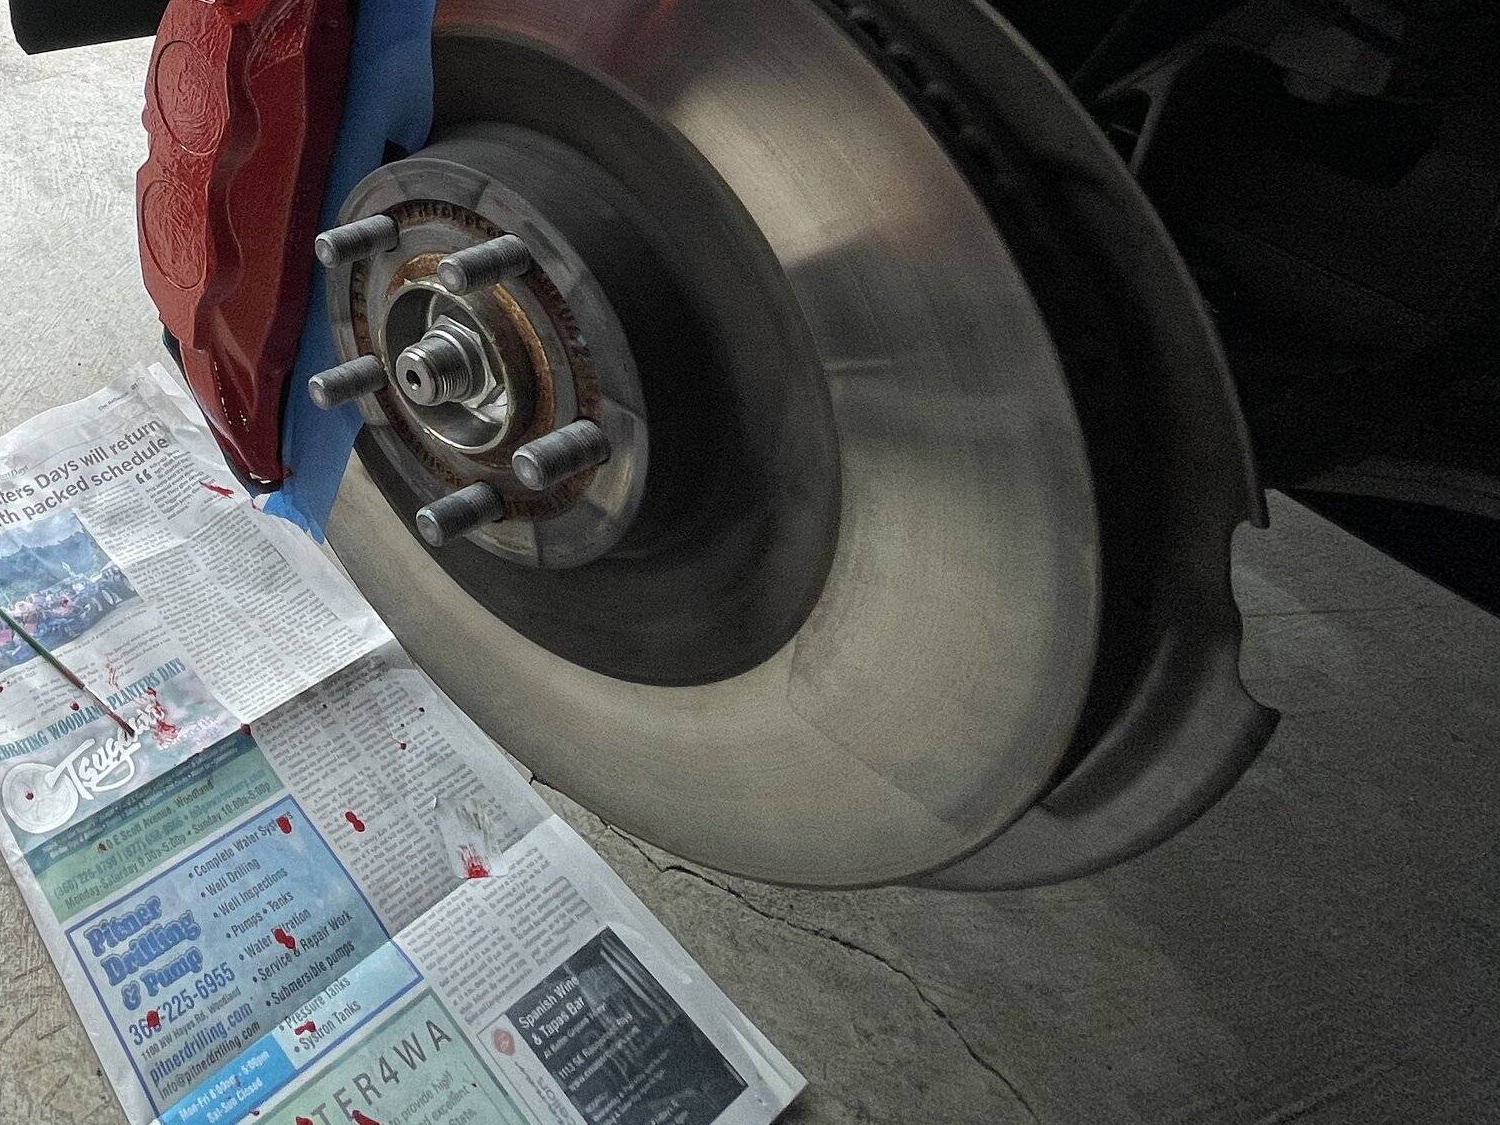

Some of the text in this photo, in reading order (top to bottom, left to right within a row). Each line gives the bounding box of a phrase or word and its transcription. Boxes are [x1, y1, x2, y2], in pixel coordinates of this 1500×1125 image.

[22, 476, 90, 521] packed
[90, 437, 170, 487] schedule
[34, 459, 79, 490] Days
[79, 447, 109, 467] will
[110, 421, 162, 455] return
[50, 702, 106, 740] WOODLAN
[157, 657, 187, 686] DAYS
[174, 779, 215, 806] Woodland
[192, 812, 223, 835] Sunday
[193, 811, 294, 877] Complete Water Systs
[206, 858, 261, 896] Well Drilling
[218, 867, 288, 917] Well Inspections
[84, 895, 162, 957] Pitner
[231, 890, 295, 937] Pumps Tanks
[101, 909, 201, 986] Drilling
[244, 934, 273, 958] Water
[257, 951, 294, 981] Service
[300, 927, 331, 952] Repair
[328, 909, 353, 932] Work
[121, 946, 203, 1011] & Pump
[271, 939, 356, 1006] Submersible pumps
[284, 977, 351, 1029] Pressure Tanks
[331, 999, 362, 1023] Tanks
[518, 994, 558, 1030] Spanish
[553, 976, 580, 1000] Wine
[531, 1033, 543, 1046] &
[541, 1012, 569, 1039] Tapas
[566, 996, 586, 1015] Bar
[149, 1000, 254, 1088] pitnerdrilling.com
[401, 1088, 434, 1124] provide
